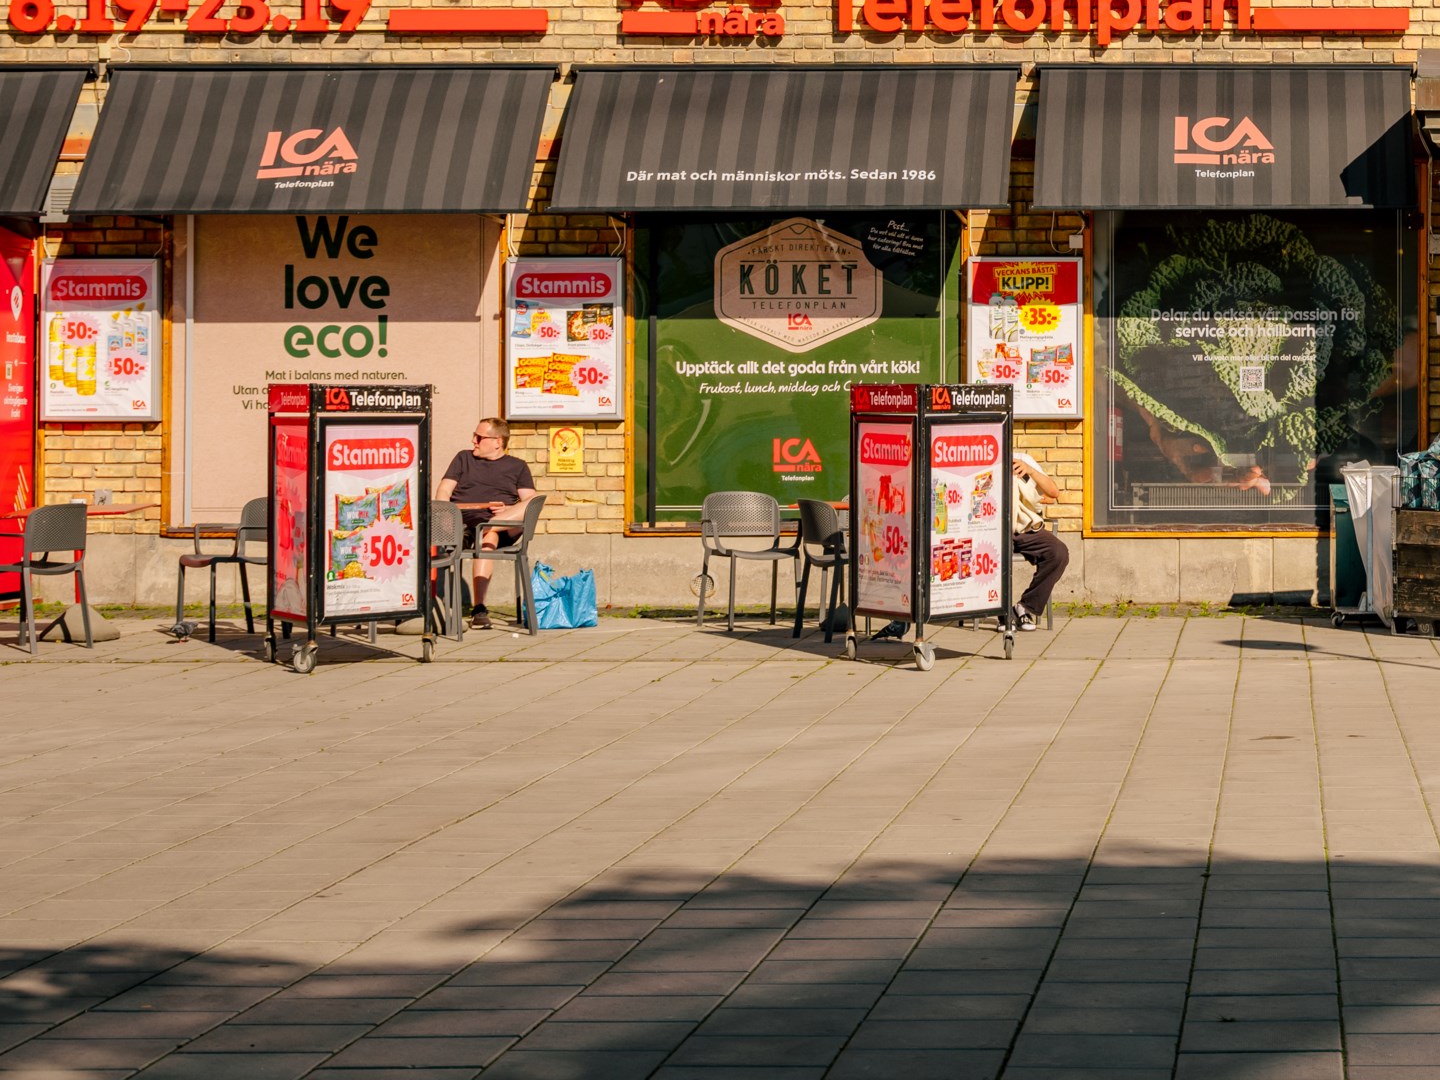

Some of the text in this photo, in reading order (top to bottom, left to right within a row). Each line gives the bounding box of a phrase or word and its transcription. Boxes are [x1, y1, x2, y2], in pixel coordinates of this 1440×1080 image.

[700, 5, 784, 35] nära
[1174, 116, 1274, 152] ICA
[260, 126, 358, 166] ICA
[1223, 150, 1275, 164] nära
[304, 161, 357, 175] nära
[626, 169, 936, 182] Där mat och människor möts. Sedan 1986
[1195, 169, 1255, 178] Telefonplan
[274, 180, 334, 189] Telefonplan
[296, 216, 378, 259] We
[740, 260, 858, 295] KÖKET
[996, 268, 1030, 276] VECKANS
[56, 279, 140, 297] Stammis
[284, 264, 390, 309] love
[521, 276, 605, 294] Stammis
[1002, 276, 1049, 290] KLIPP!
[752, 302, 846, 310] TELEFONPLAN
[788, 314, 812, 326] ICA
[1150, 306, 1360, 324] Delar du också vår passion för
[284, 314, 388, 358] eco!
[1175, 324, 1336, 338] service och hållbarhet?
[265, 370, 408, 380] Mat i balans med naturen.
[676, 360, 920, 377] Upptäck allt det goda från vårt kök!
[232, 386, 258, 395] Utan
[699, 383, 742, 394] Frukost,
[744, 382, 776, 394] lunch,
[778, 381, 819, 396] middag
[822, 382, 840, 392] och
[132, 400, 146, 408] ICA
[242, 400, 254, 410] Vi
[280, 392, 306, 407] Telefonplan
[326, 388, 422, 409] ICA Telefonplan
[598, 396, 611, 404] ICA
[855, 390, 912, 410] ICA Telefonplan
[932, 388, 950, 405] ICA
[951, 390, 1006, 408] Telefonplan
[1058, 398, 1072, 406] ICA
[332, 442, 409, 466] Stammis
[773, 438, 822, 463] ICA
[863, 438, 910, 459] Stammis
[935, 440, 994, 463] Stammis
[796, 461, 822, 472] nära
